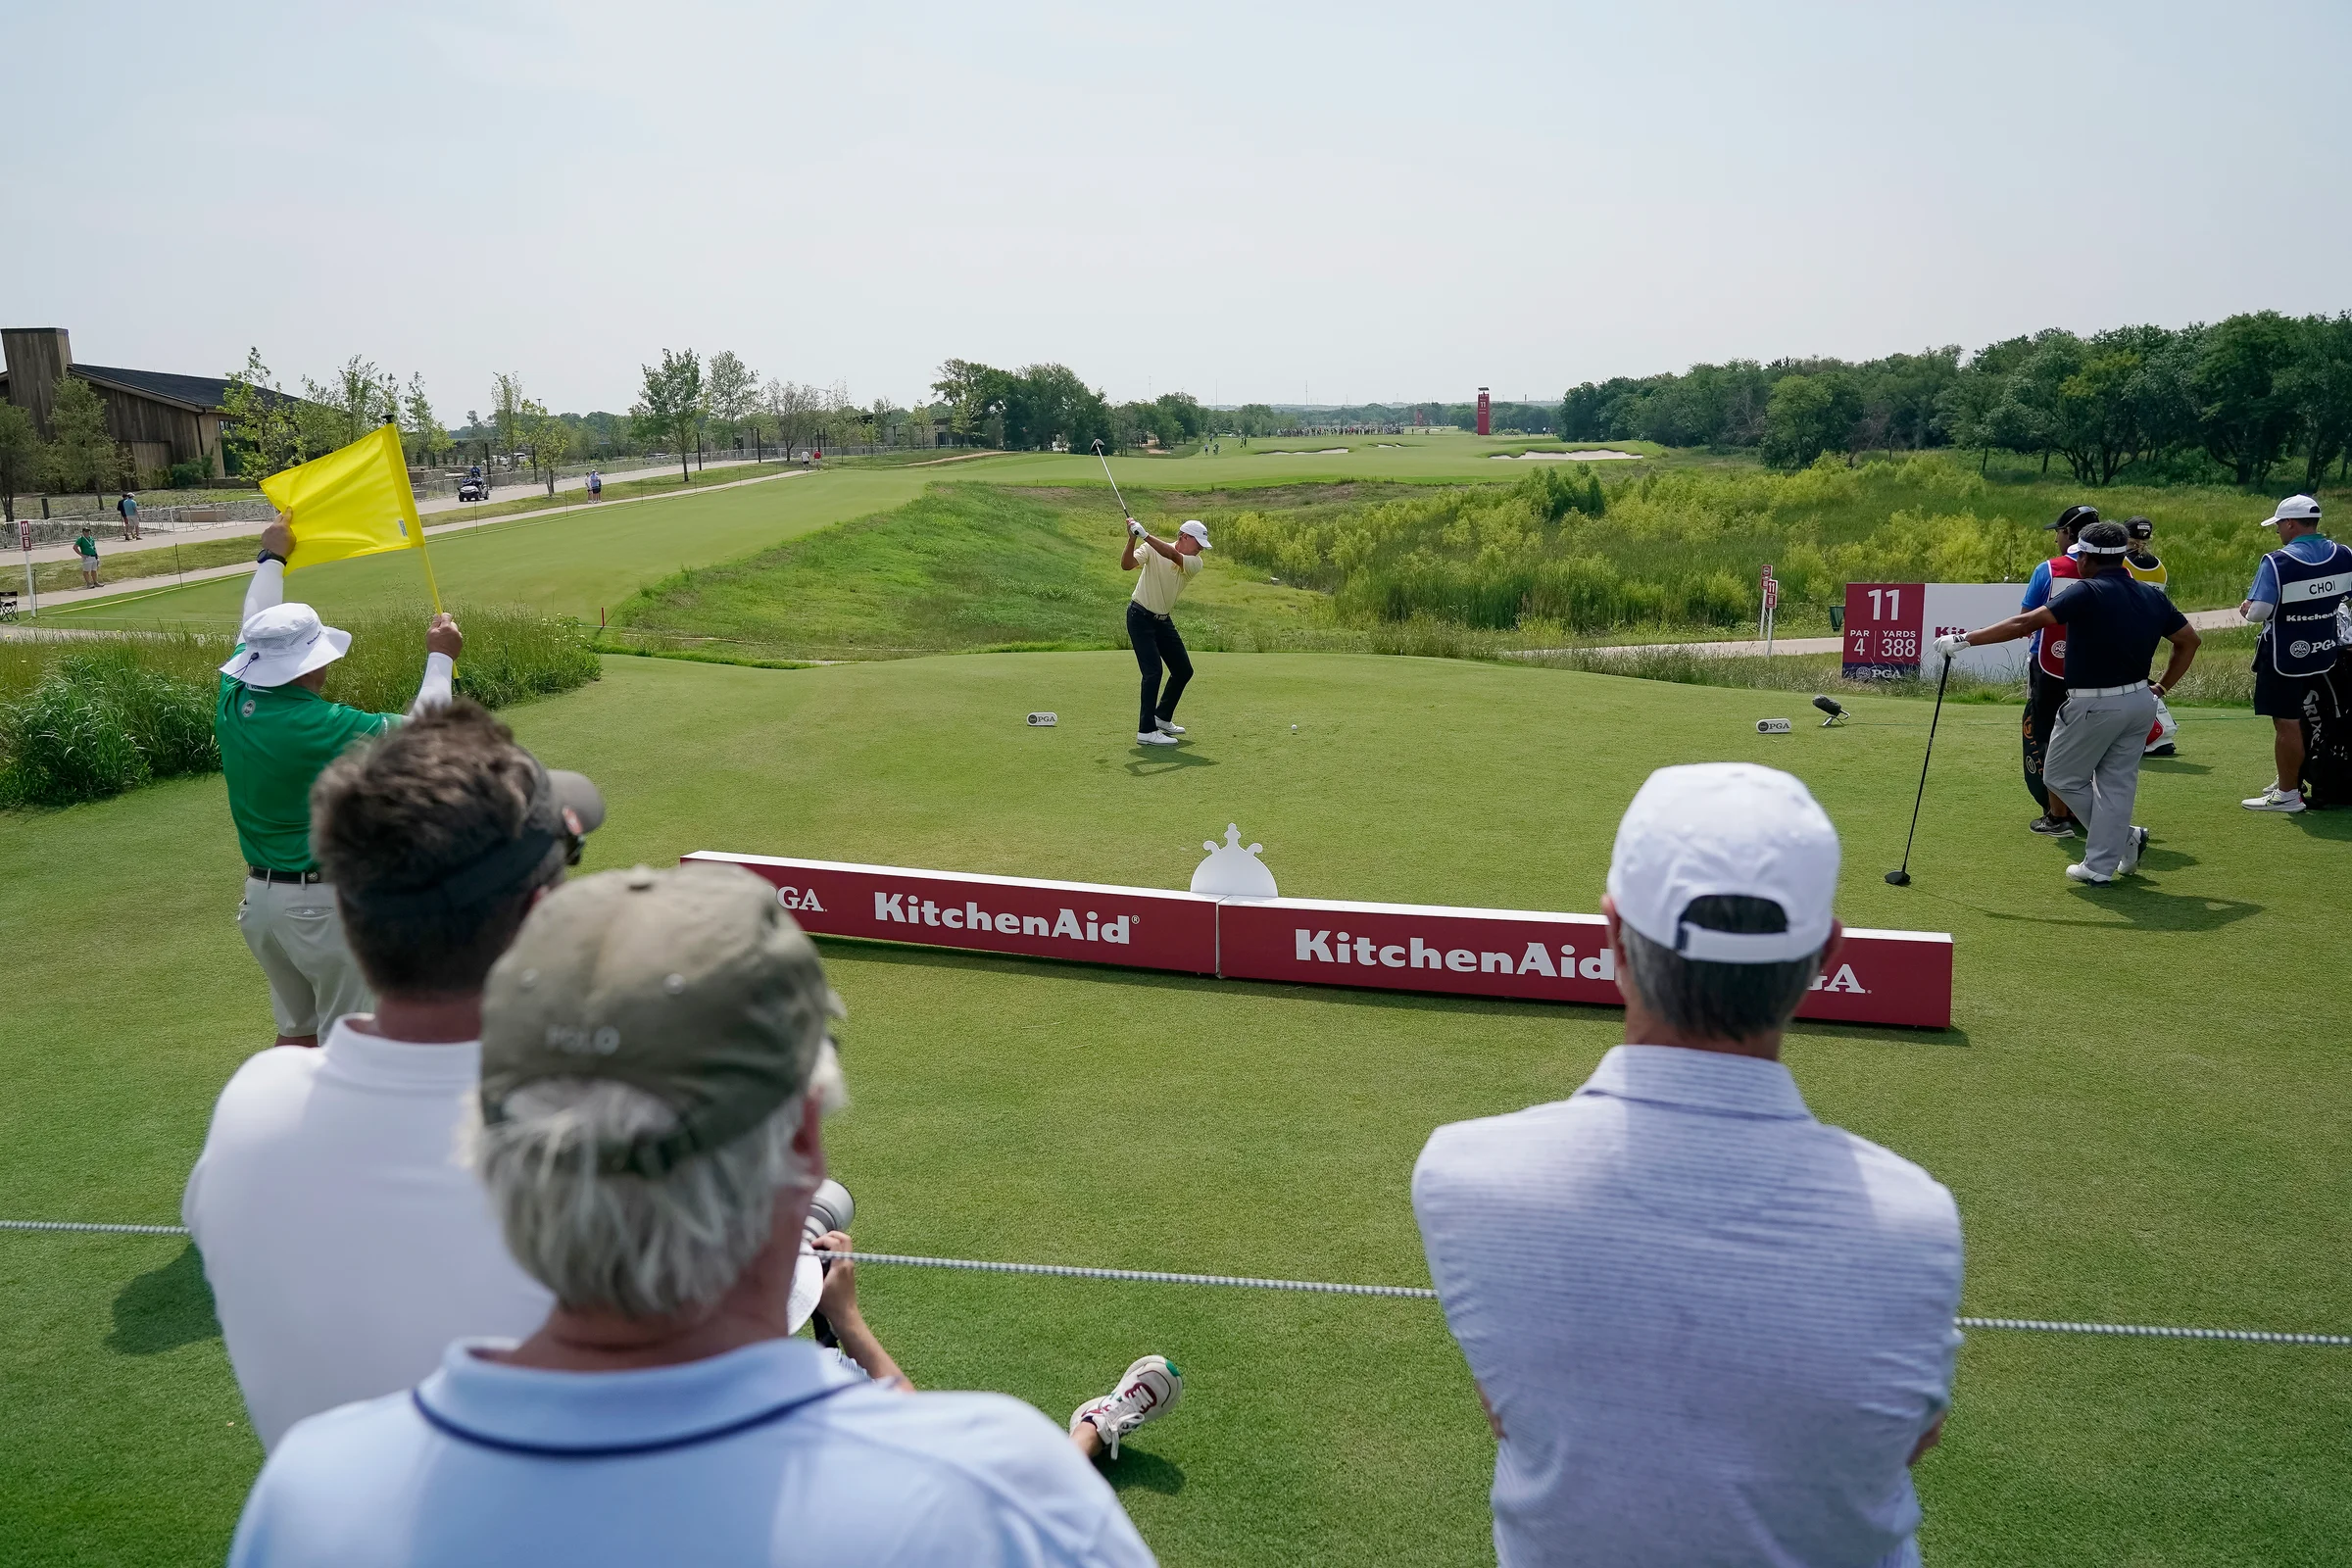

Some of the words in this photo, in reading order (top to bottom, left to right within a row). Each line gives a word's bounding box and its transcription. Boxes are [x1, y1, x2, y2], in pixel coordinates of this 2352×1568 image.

[23, 522, 29, 535] 11
[1768, 582, 1775, 594] 11
[2309, 580, 2336, 595] CHOI
[1867, 589, 1900, 621] 11
[1853, 638, 1866, 657] 4
[1881, 638, 1916, 658] 388
[1872, 668, 1902, 679] PGA
[774, 886, 824, 912] GA
[1295, 928, 1615, 981] KitchenAid
